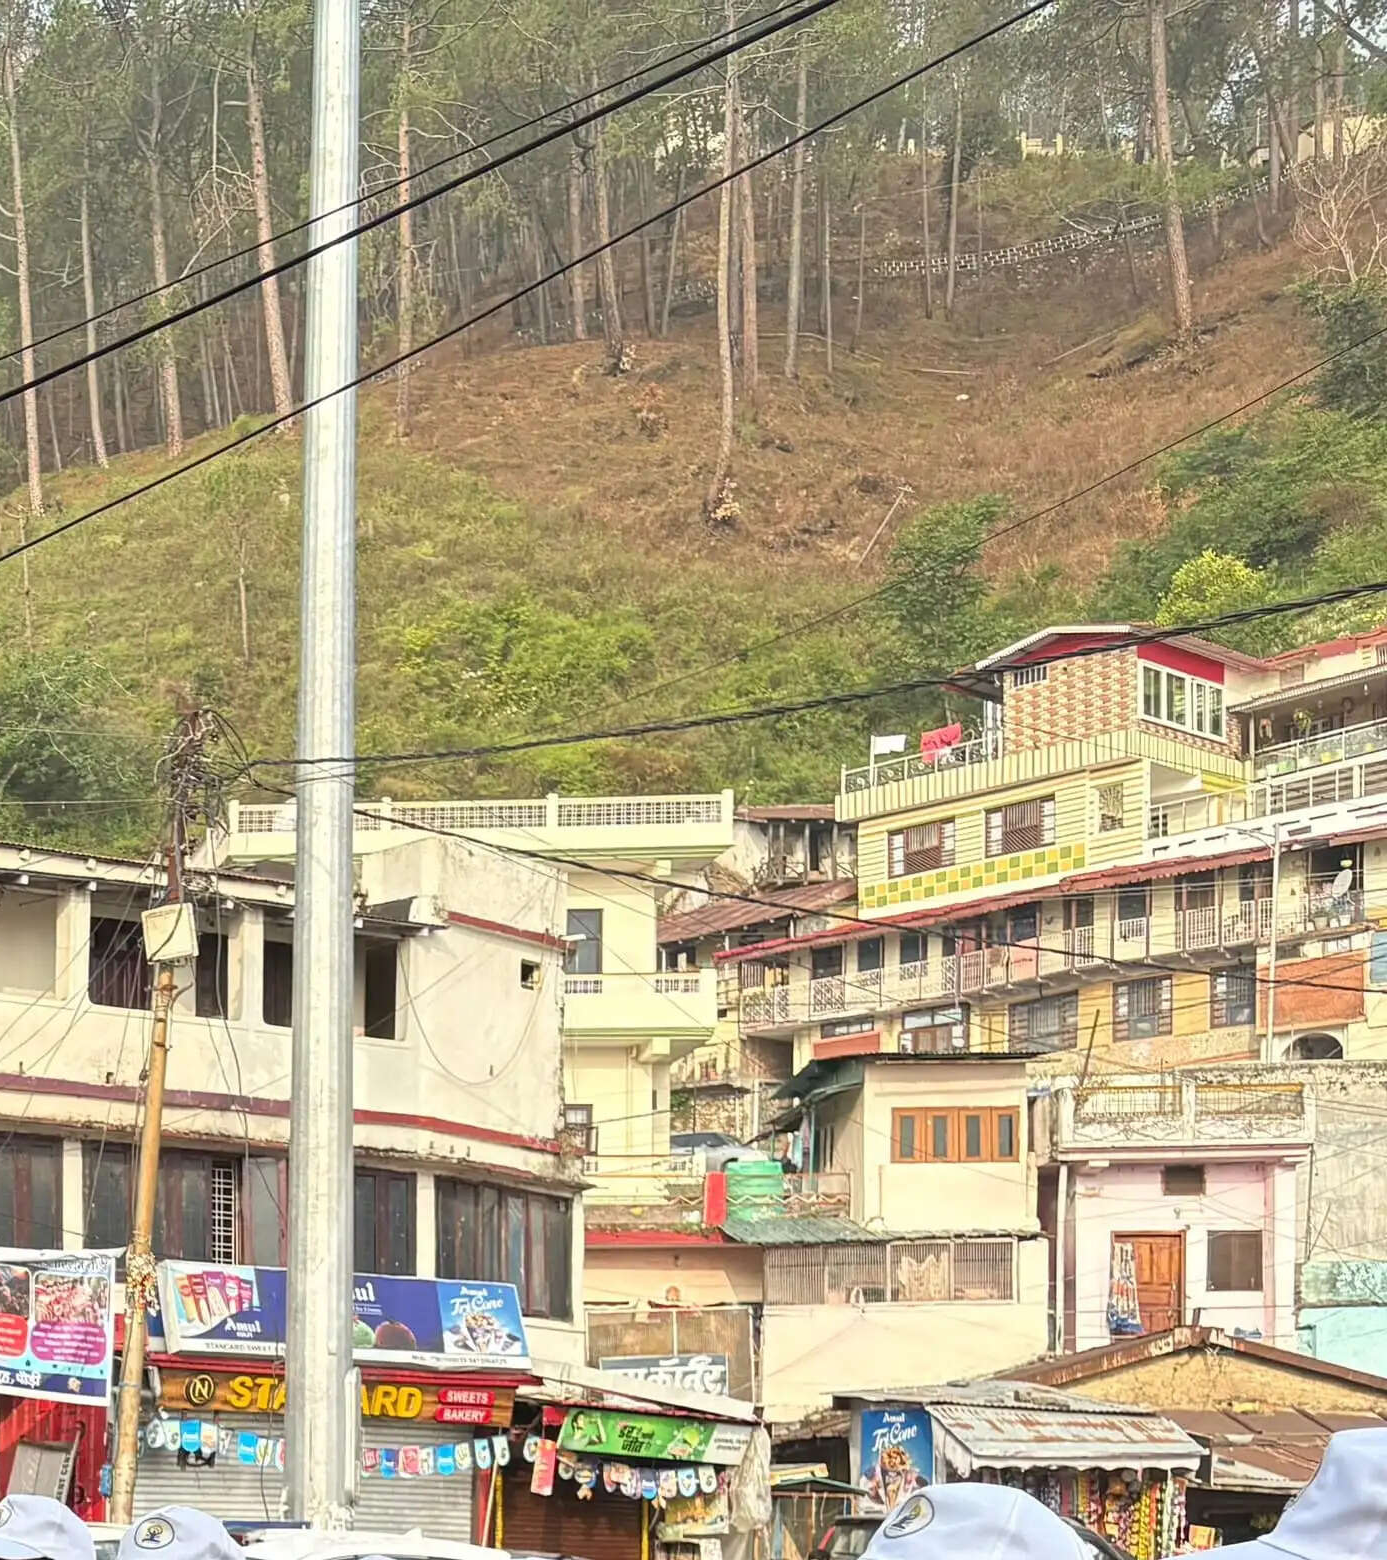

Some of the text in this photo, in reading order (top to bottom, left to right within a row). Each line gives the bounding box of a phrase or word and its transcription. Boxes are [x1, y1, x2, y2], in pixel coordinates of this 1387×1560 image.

[353, 1281, 376, 1302] ul
[225, 1317, 262, 1333] Amul
[446, 1389, 489, 1405] SWEETS
[443, 1410, 487, 1423] BAKERY
[883, 1412, 906, 1423] Amul
